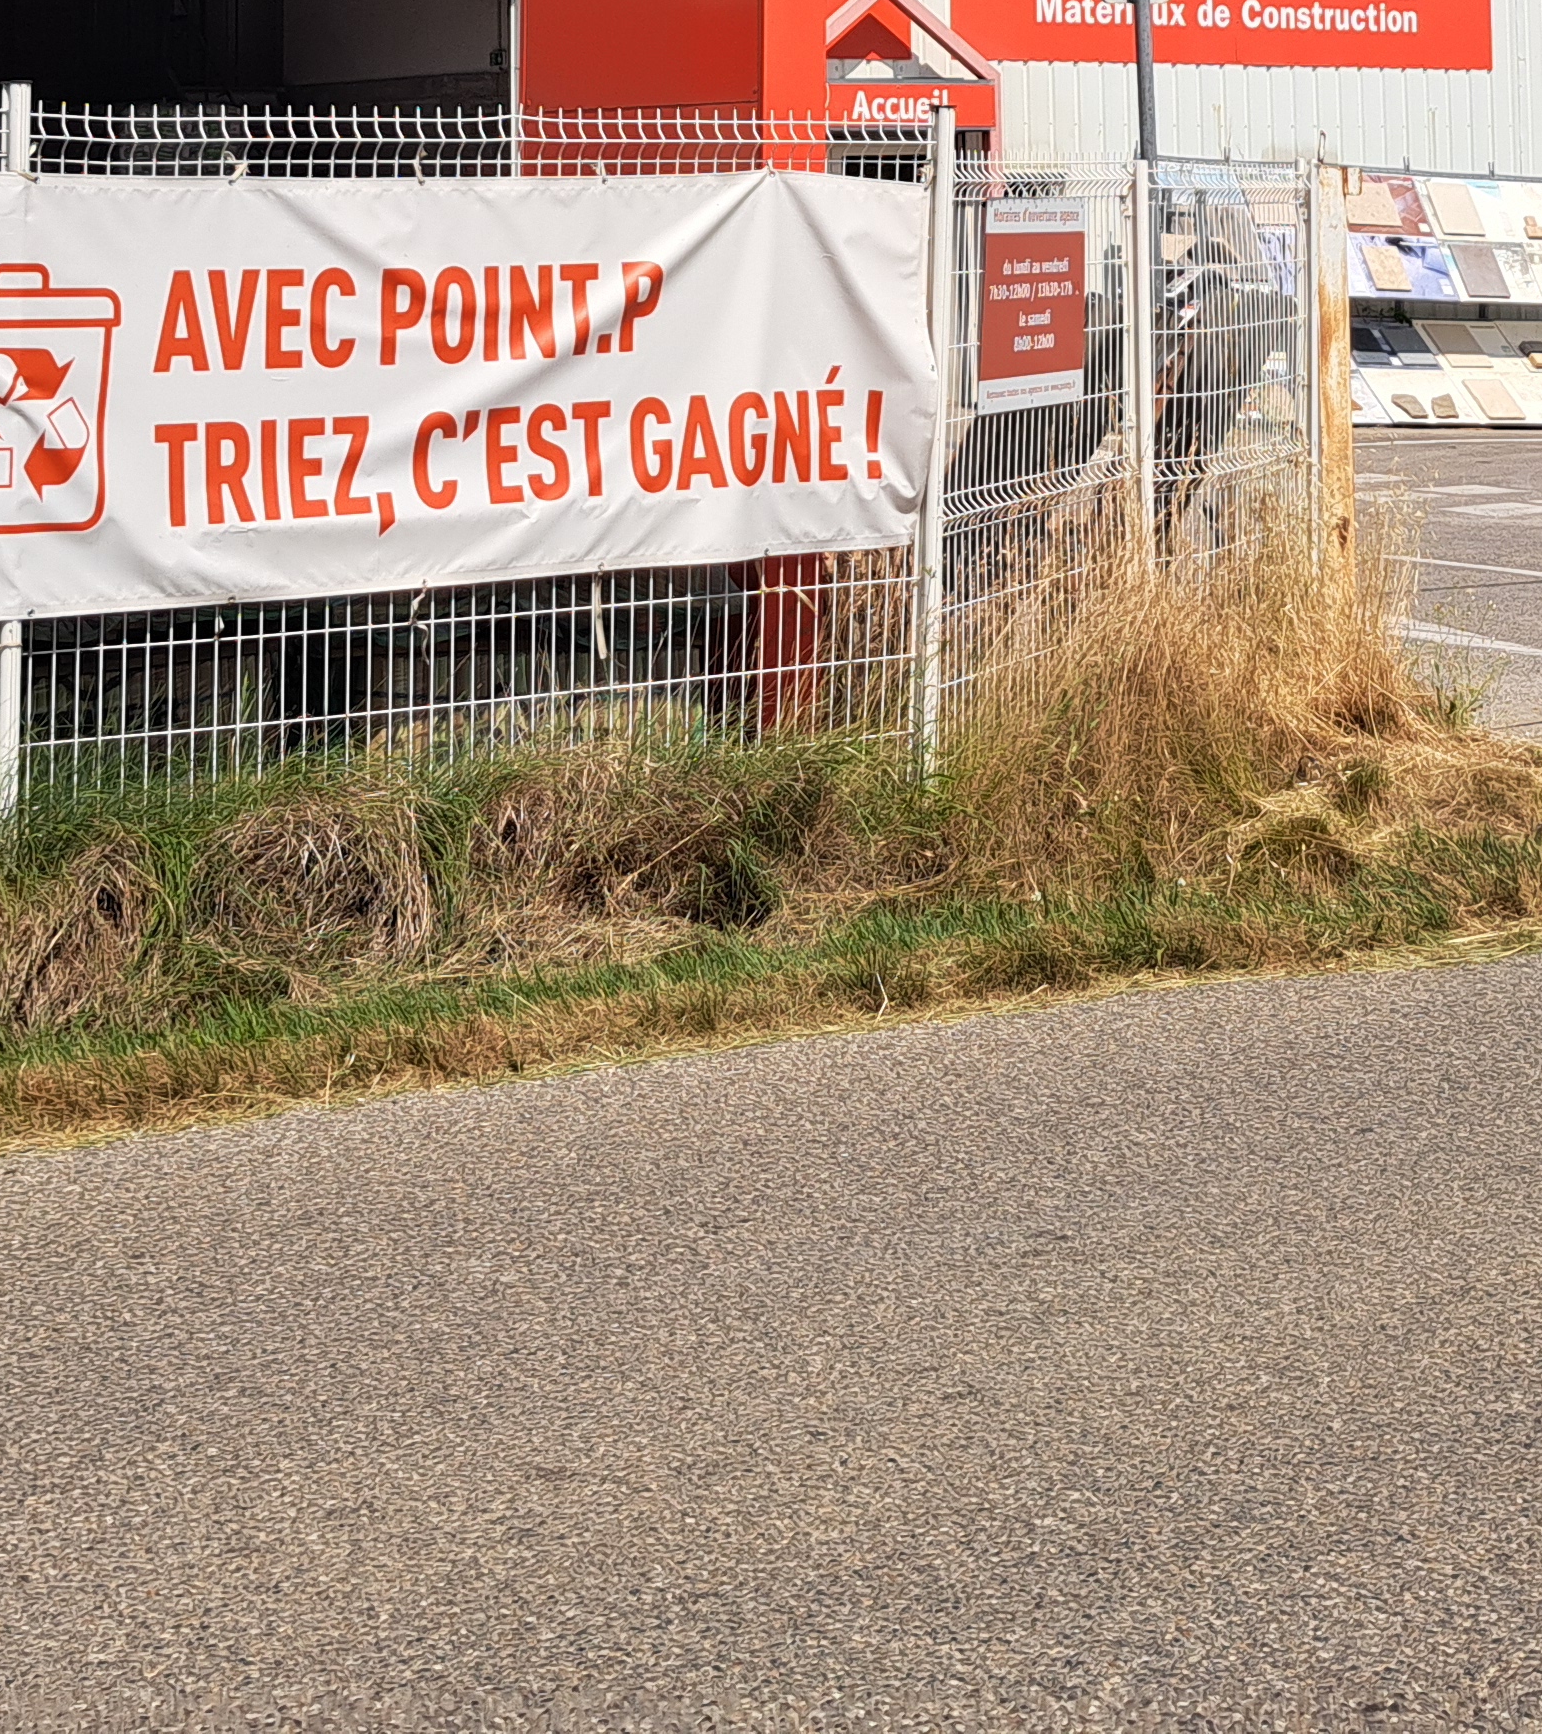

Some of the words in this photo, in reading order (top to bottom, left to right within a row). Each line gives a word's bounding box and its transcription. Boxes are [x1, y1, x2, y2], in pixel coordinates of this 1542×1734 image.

[1242, 0, 1418, 33] Construction
[153, 266, 356, 374] AVEC
[380, 261, 664, 366] POINT.P
[154, 415, 395, 537] TRIEZ,
[411, 399, 610, 510] C'EST
[629, 365, 847, 494] GAGNÉ
[864, 389, 883, 479] !
